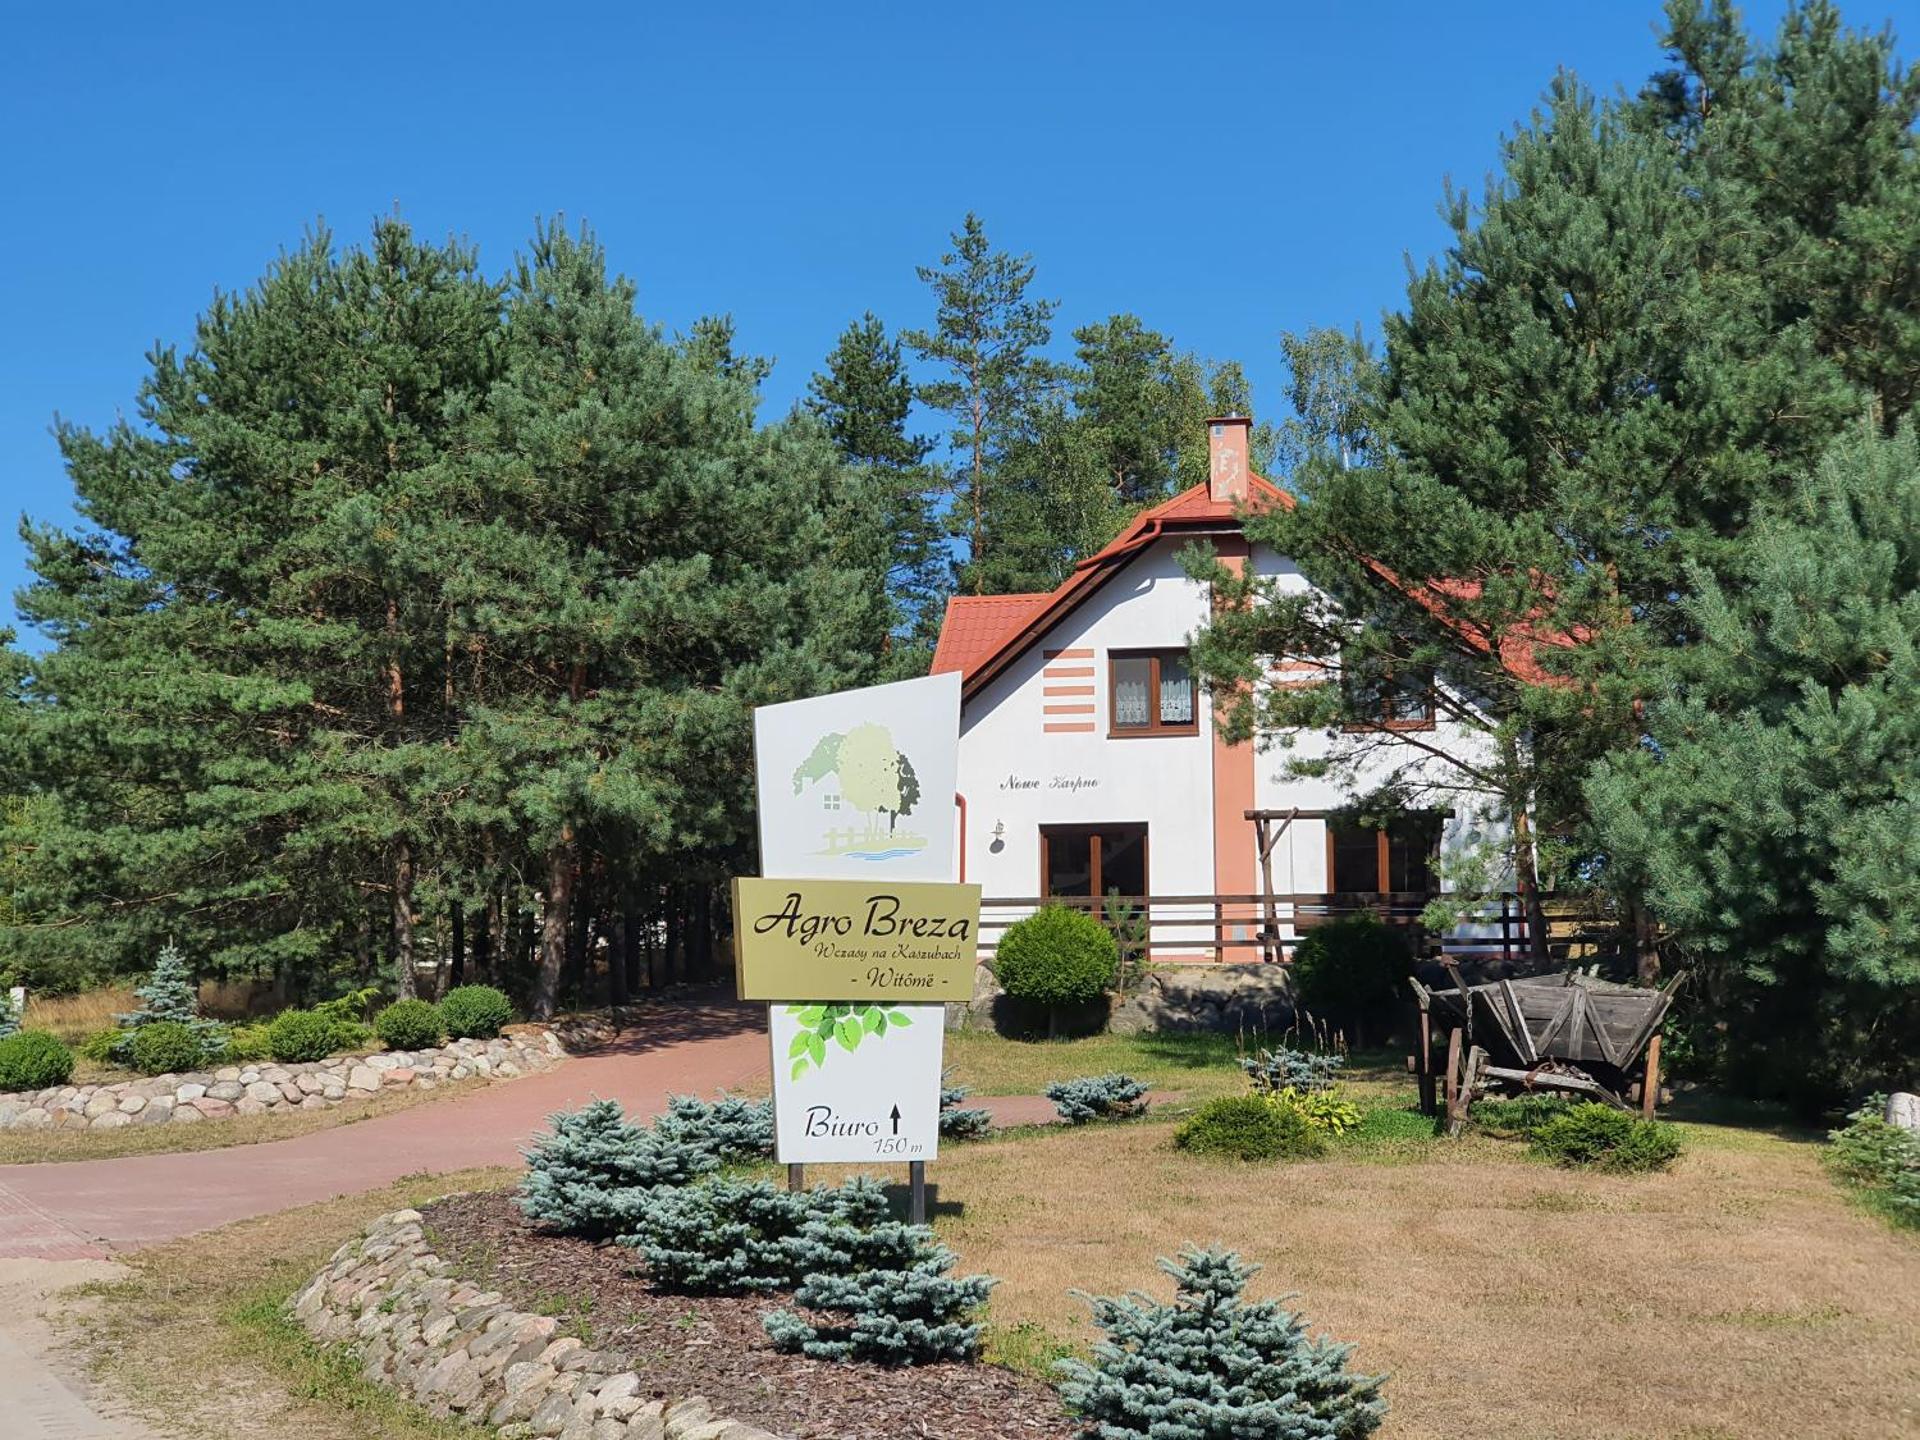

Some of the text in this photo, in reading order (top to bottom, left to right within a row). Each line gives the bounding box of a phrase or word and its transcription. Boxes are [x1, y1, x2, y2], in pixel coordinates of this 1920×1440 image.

[999, 773, 1040, 790] Nowe
[754, 892, 970, 946] Agro Breza
[814, 943, 961, 962] Wczasy na Kaszubach
[866, 966, 934, 988] Witômë
[804, 1105, 879, 1137] Biuro
[873, 1137, 923, 1154] 150 m
